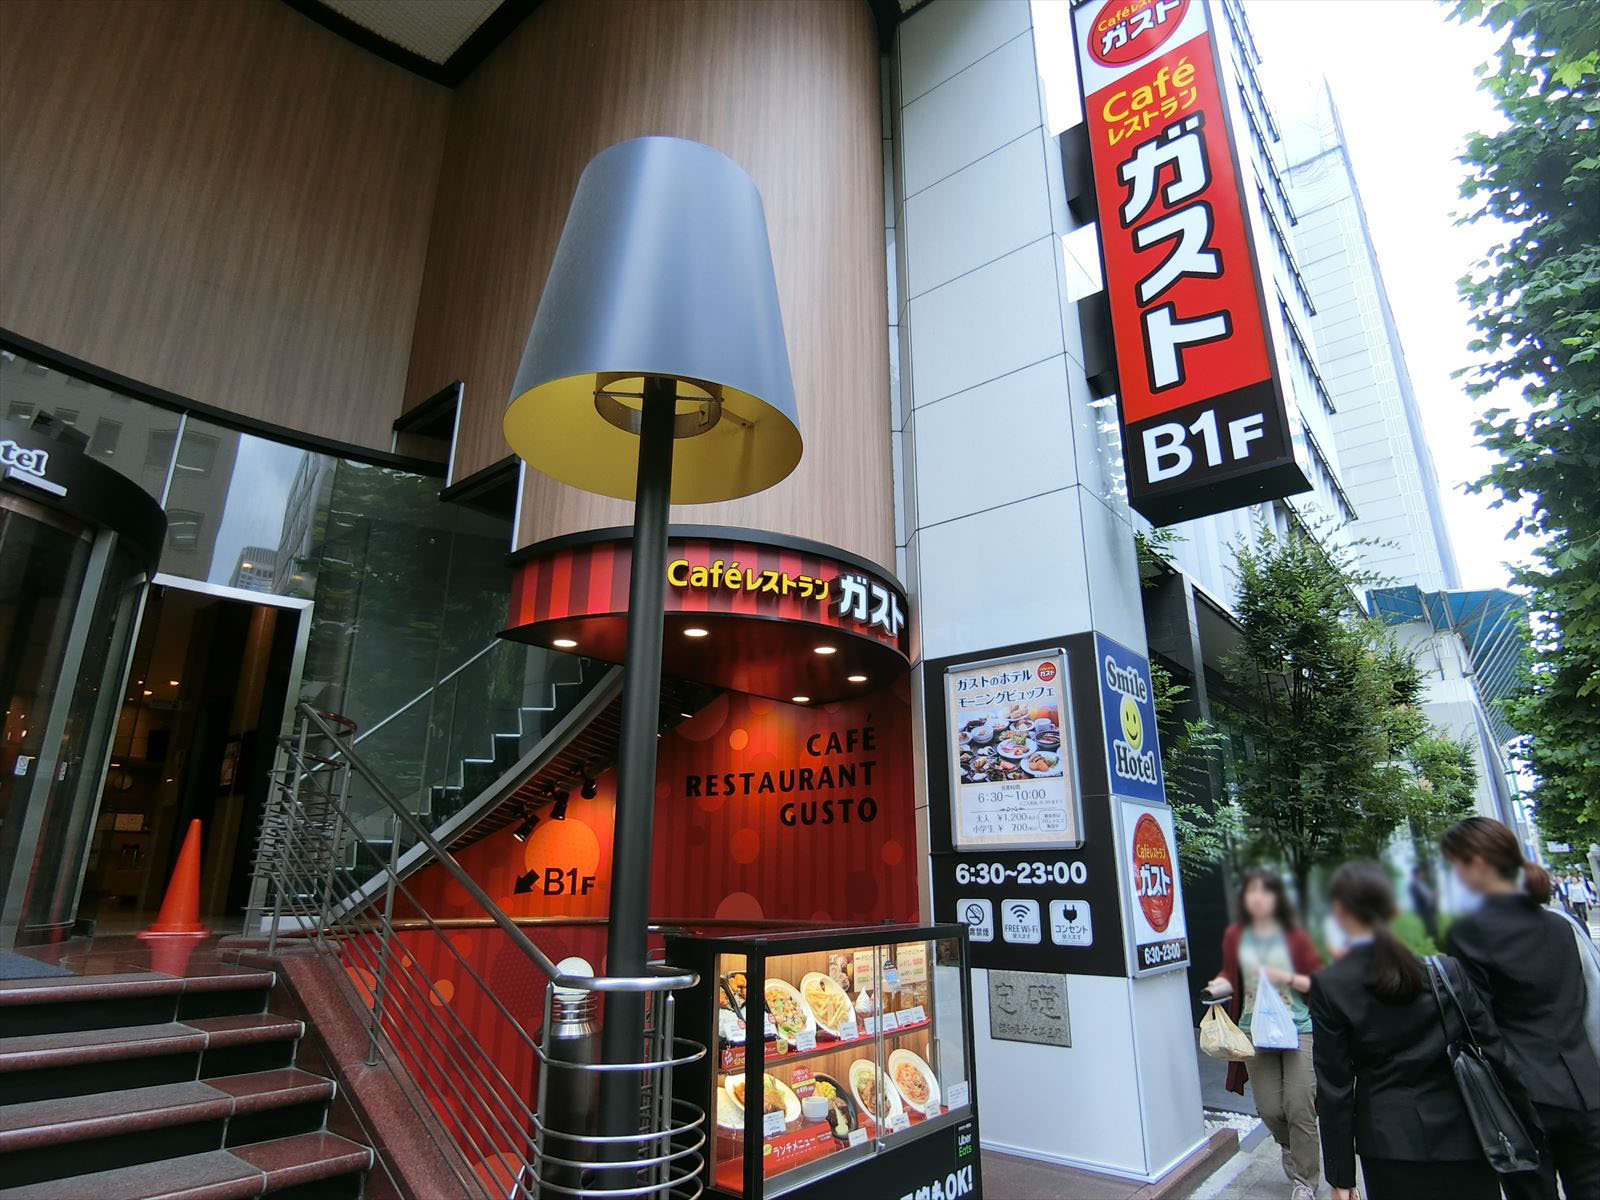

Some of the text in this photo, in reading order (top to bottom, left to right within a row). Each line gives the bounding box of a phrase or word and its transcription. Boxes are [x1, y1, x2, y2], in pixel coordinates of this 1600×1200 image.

[1100, 0, 1182, 57] ガスト
[1103, 56, 1195, 123] Café
[1107, 86, 1197, 146] レストラン
[1119, 114, 1230, 391] ガスト
[1142, 409, 1264, 484] B1F
[839, 574, 904, 637] ガスト
[957, 669, 1033, 691] ガストのホテル
[1106, 656, 1147, 703] Smile
[958, 686, 1055, 708] モーニングビュッフェ
[806, 714, 877, 757] CAFÉ
[686, 761, 877, 797] RESTAURANT
[1114, 741, 1157, 783] Hotel
[780, 797, 878, 827] GUSTO
[973, 824, 995, 834] 小学生
[1011, 823, 1028, 832] 700
[543, 867, 596, 896] B1F
[1139, 863, 1171, 897] ガスト
[969, 927, 990, 937] 席禁煙
[1005, 924, 1038, 933] FREE Wi-Fi
[1055, 925, 1088, 934] コンセント
[995, 982, 1062, 1019] 定礎
[773, 1137, 816, 1157] ランチメニュー
[958, 1133, 972, 1146] Uber
[958, 1145, 972, 1158] Eats
